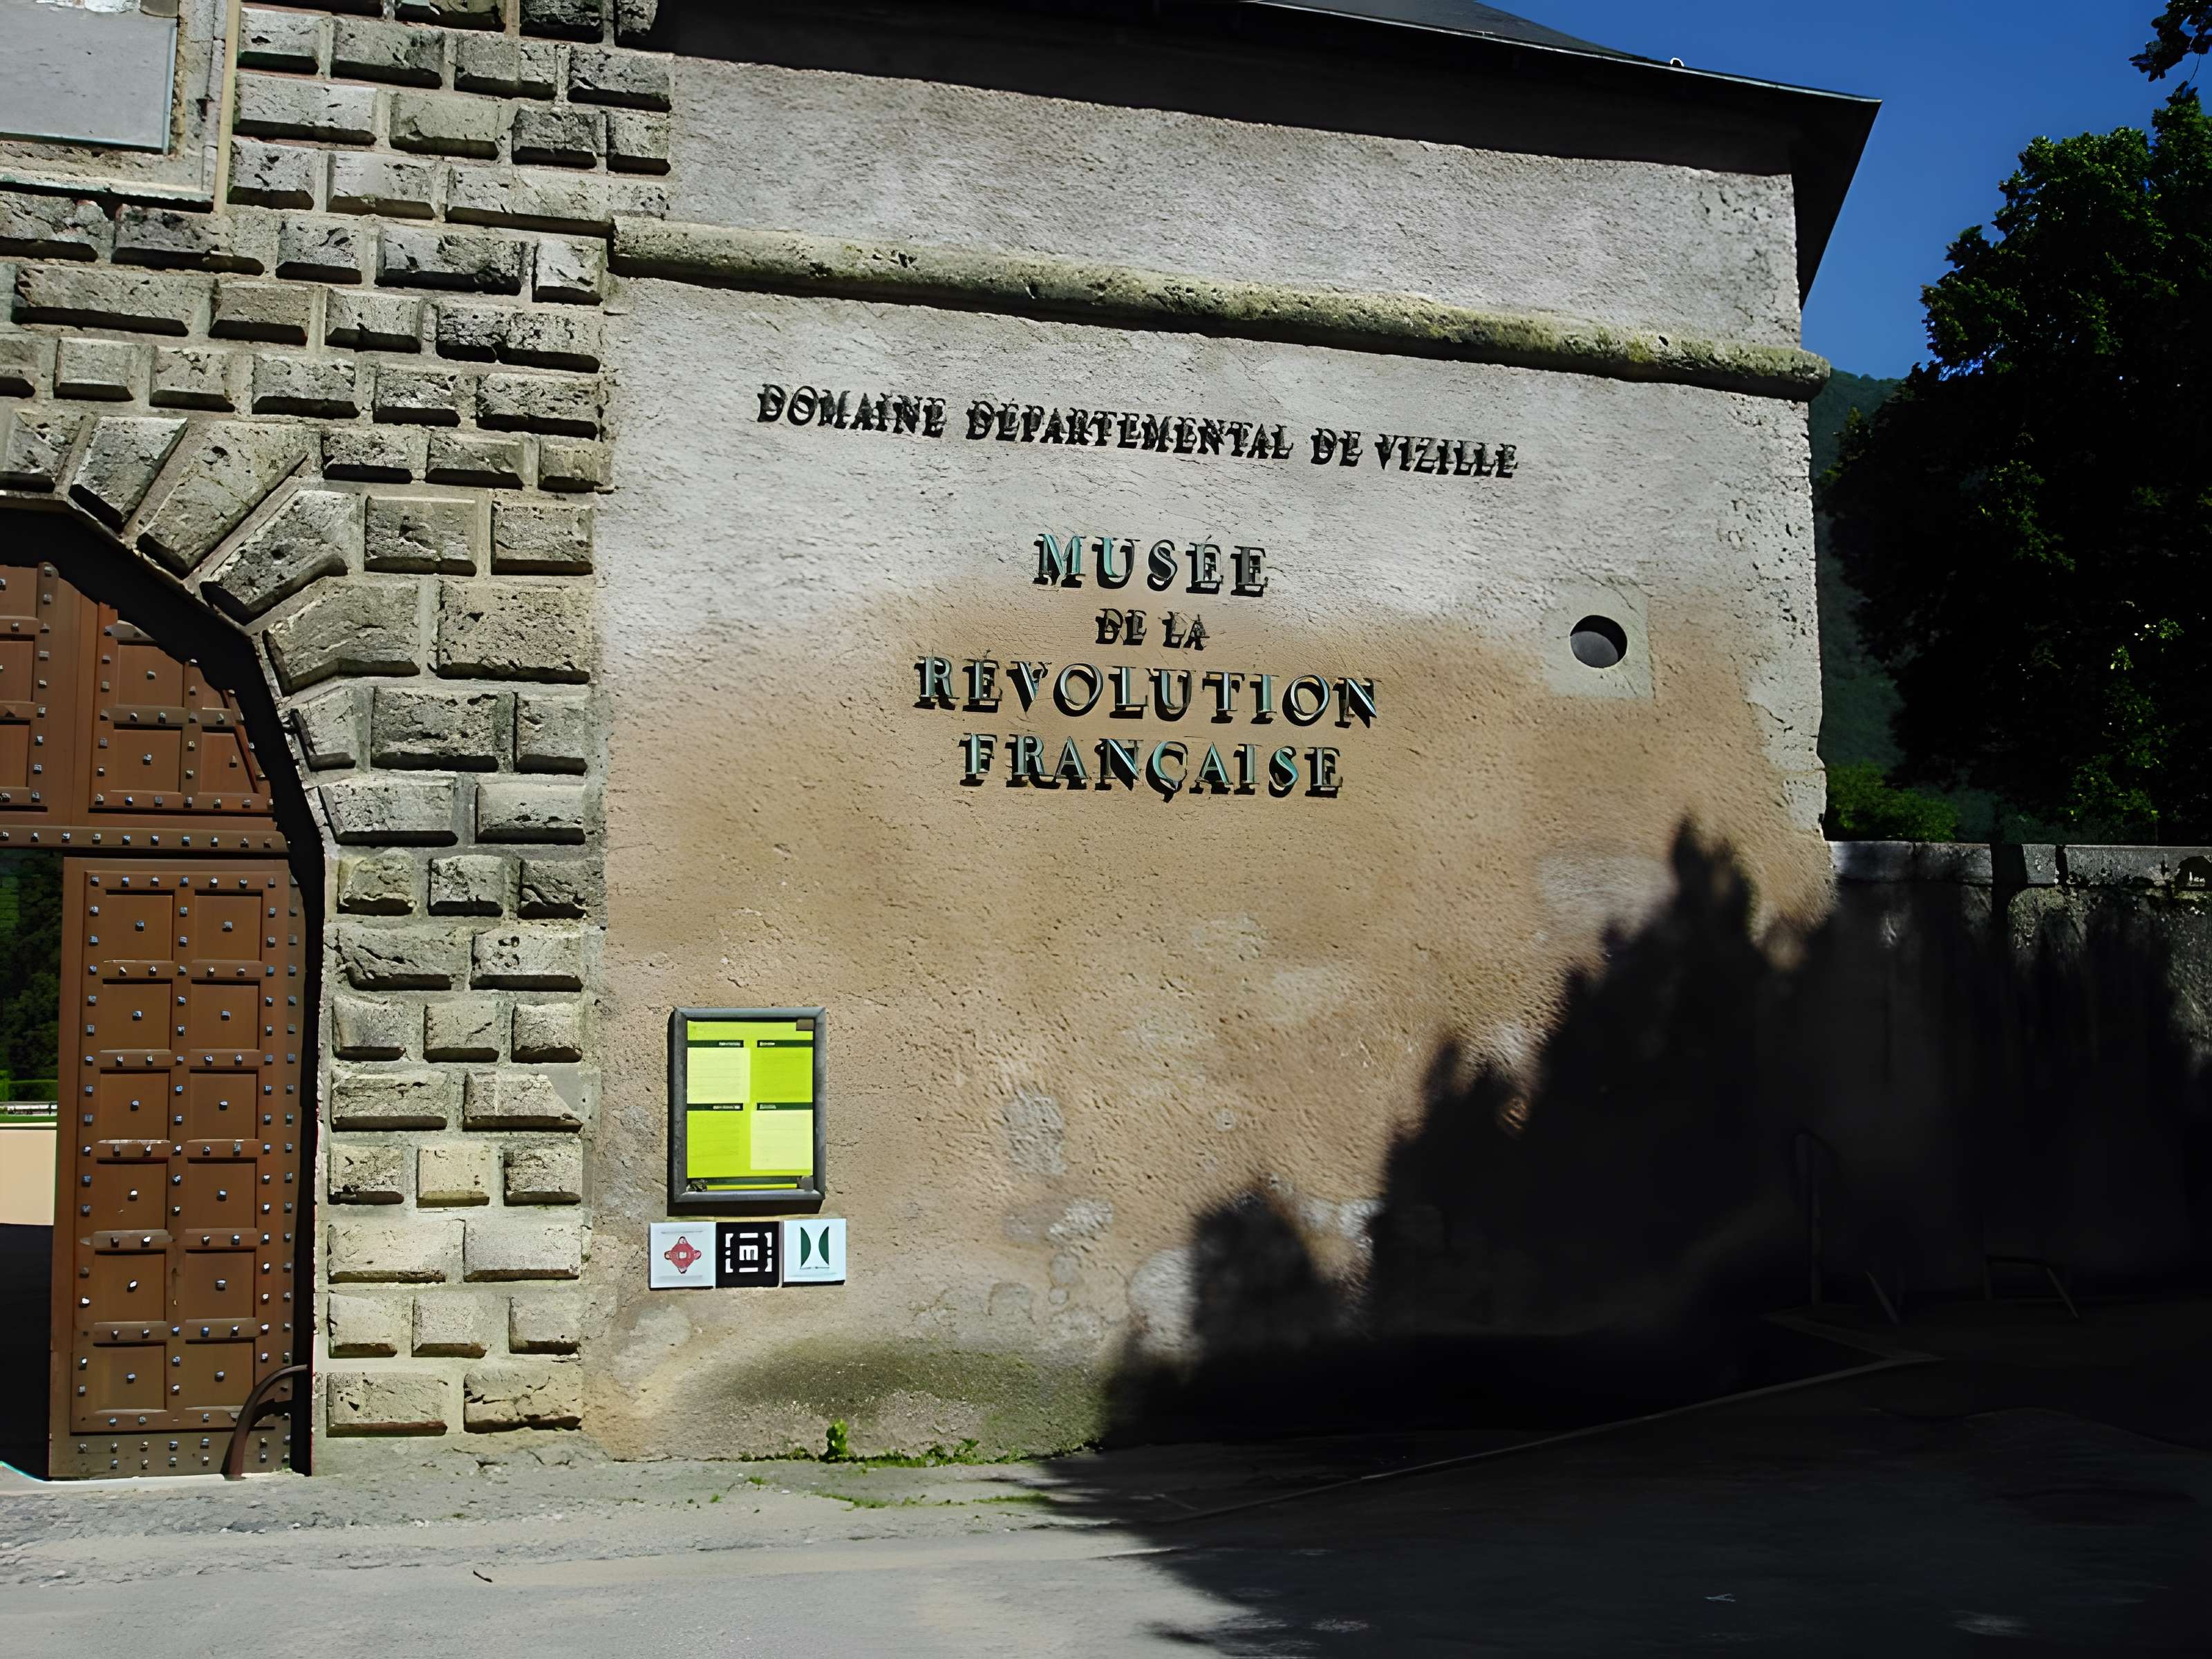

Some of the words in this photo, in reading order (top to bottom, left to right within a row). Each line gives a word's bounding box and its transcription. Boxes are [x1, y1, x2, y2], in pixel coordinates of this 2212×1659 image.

[757, 384, 947, 438] DOMAINE
[1311, 427, 1363, 467] DE
[1374, 433, 1519, 478] VIZILLE
[1095, 608, 1147, 646] DE
[1161, 610, 1210, 650] LA
[958, 731, 1343, 803] FRANÇAISE
